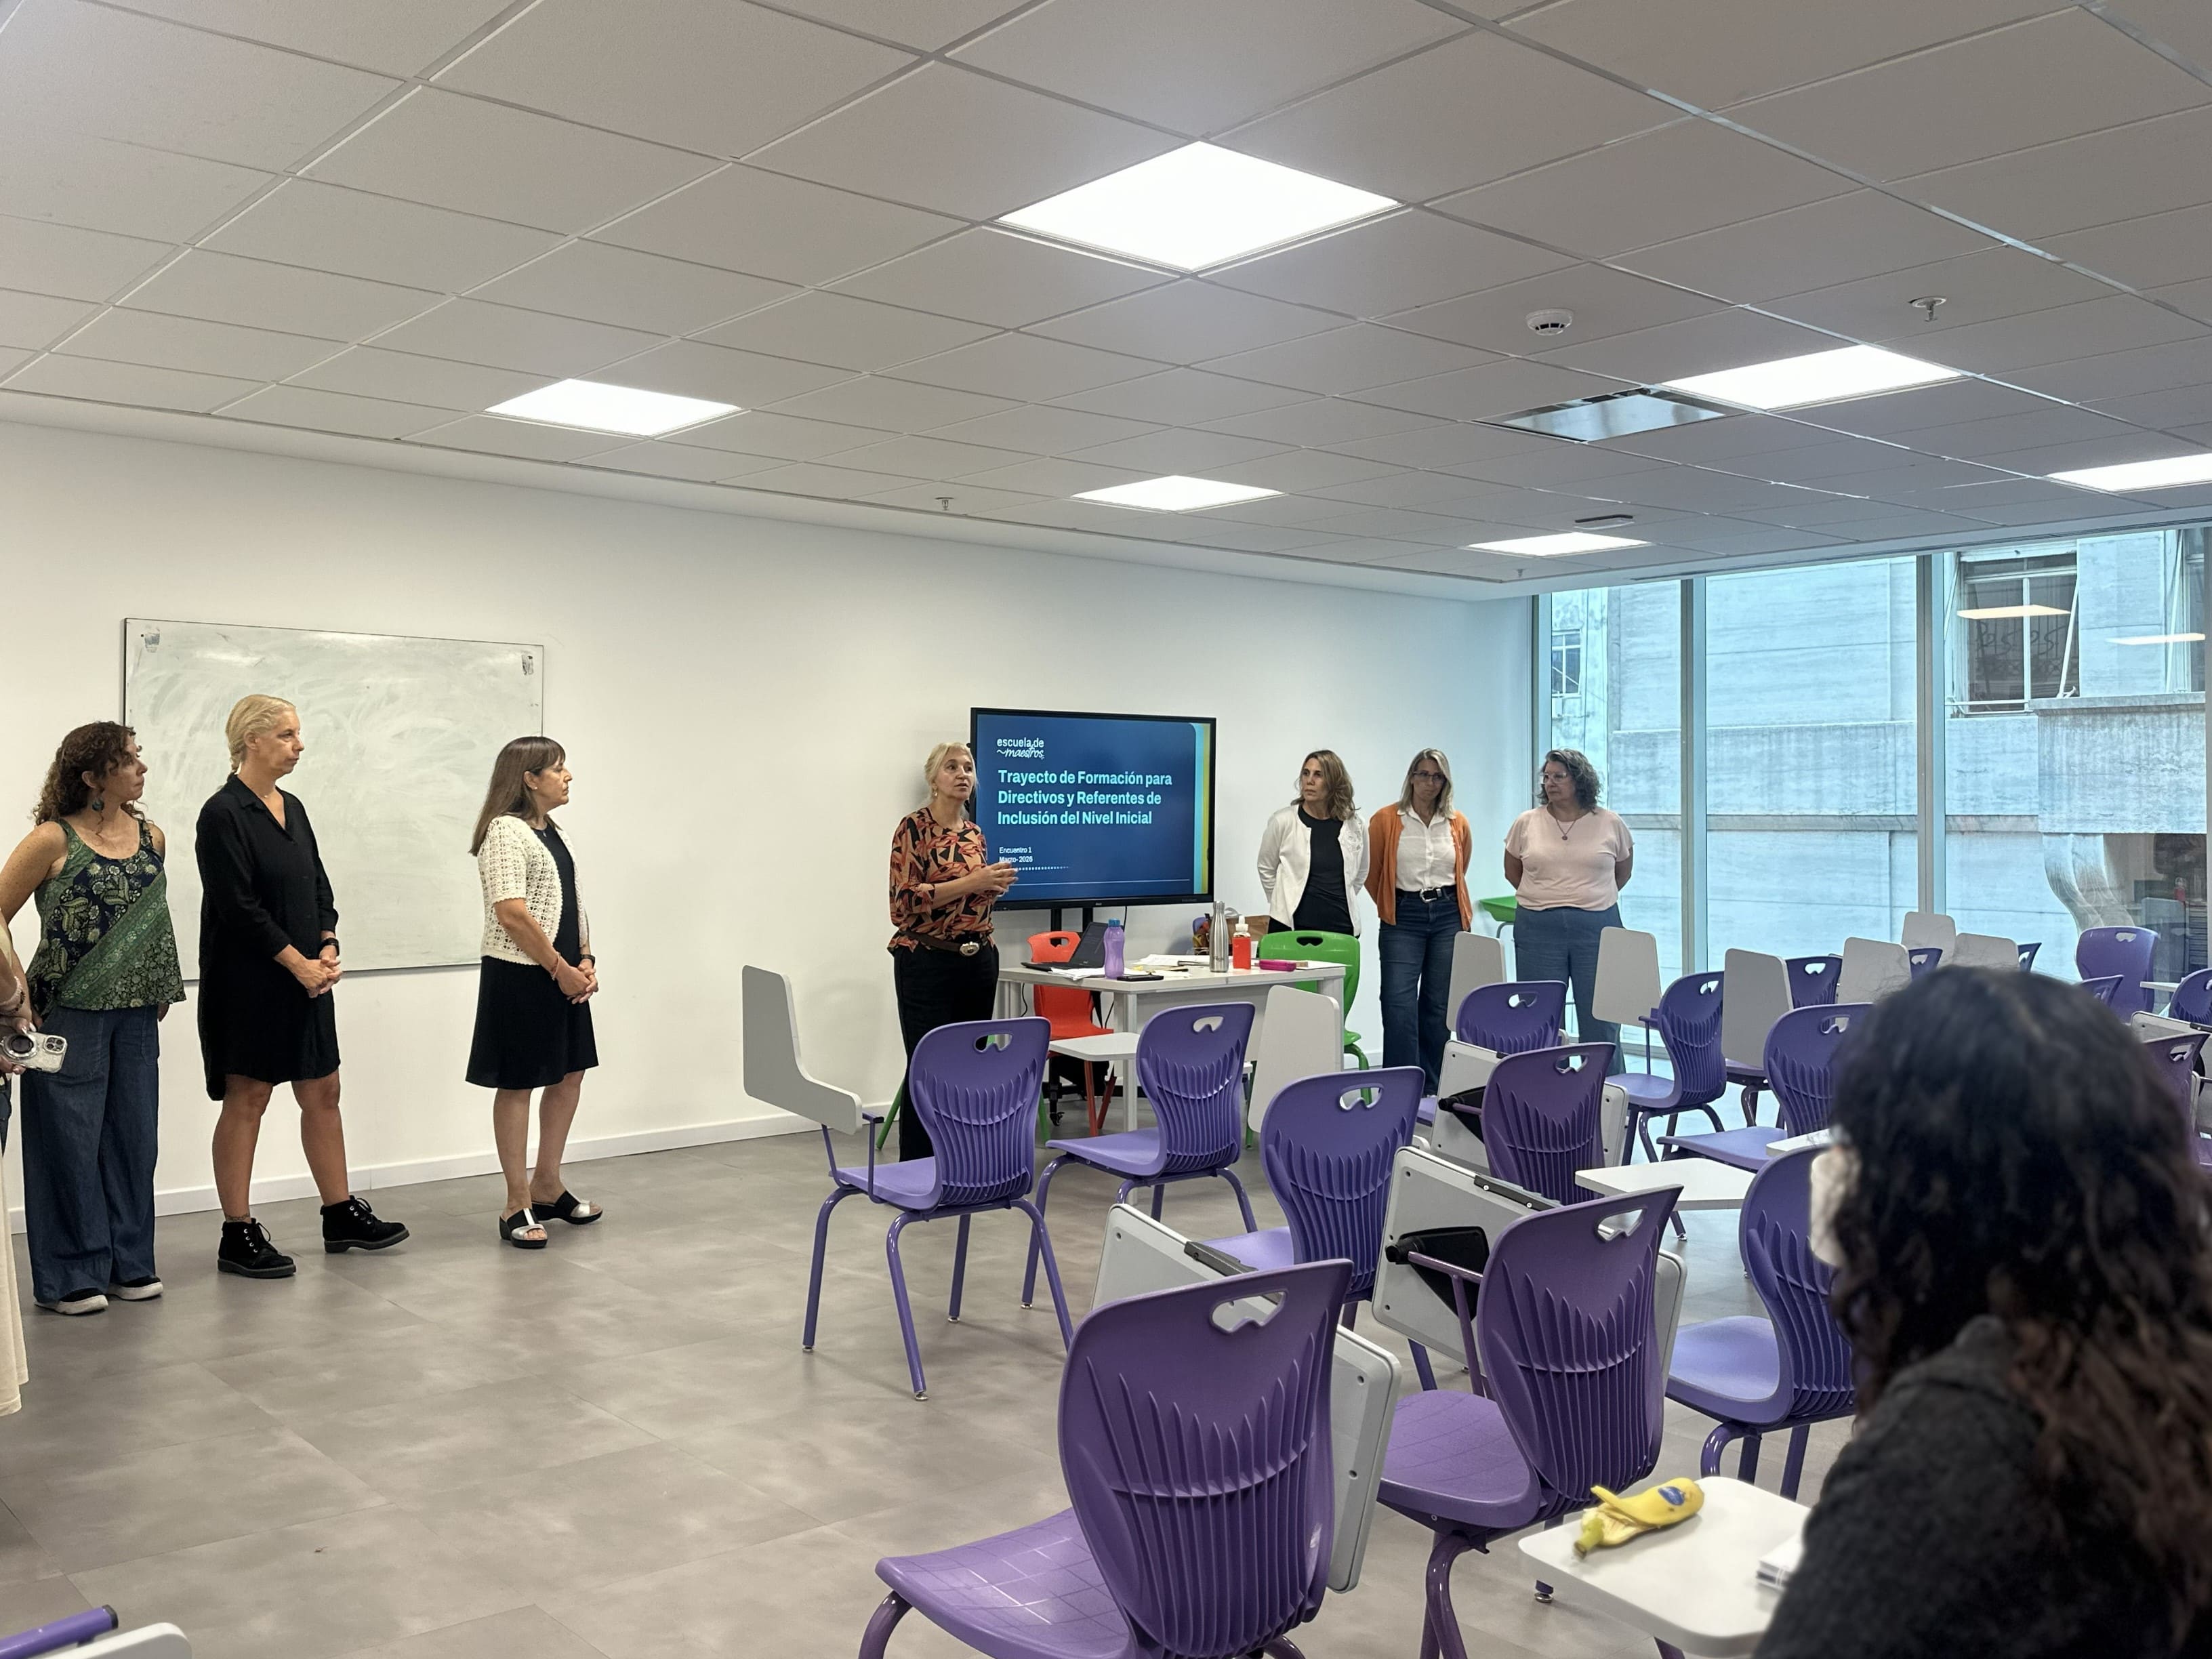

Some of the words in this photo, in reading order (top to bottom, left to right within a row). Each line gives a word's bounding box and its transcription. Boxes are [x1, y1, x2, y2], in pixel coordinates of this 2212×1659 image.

[997, 737, 1031, 747] escuela
[1033, 737, 1044, 747] de
[1004, 746, 1044, 758] maestros
[998, 770, 1057, 786] Trayecto
[1059, 771, 1075, 783] de
[1078, 771, 1143, 785] Formación
[1145, 775, 1172, 787] para
[998, 790, 1065, 804] Directivos
[1067, 794, 1075, 807] y
[1077, 790, 1145, 804] Referentes
[1147, 792, 1162, 804] de
[998, 811, 1058, 825] Inclusión
[1060, 811, 1080, 824] del
[1082, 811, 1113, 824] Nivel
[1115, 811, 1152, 824] Inicial
